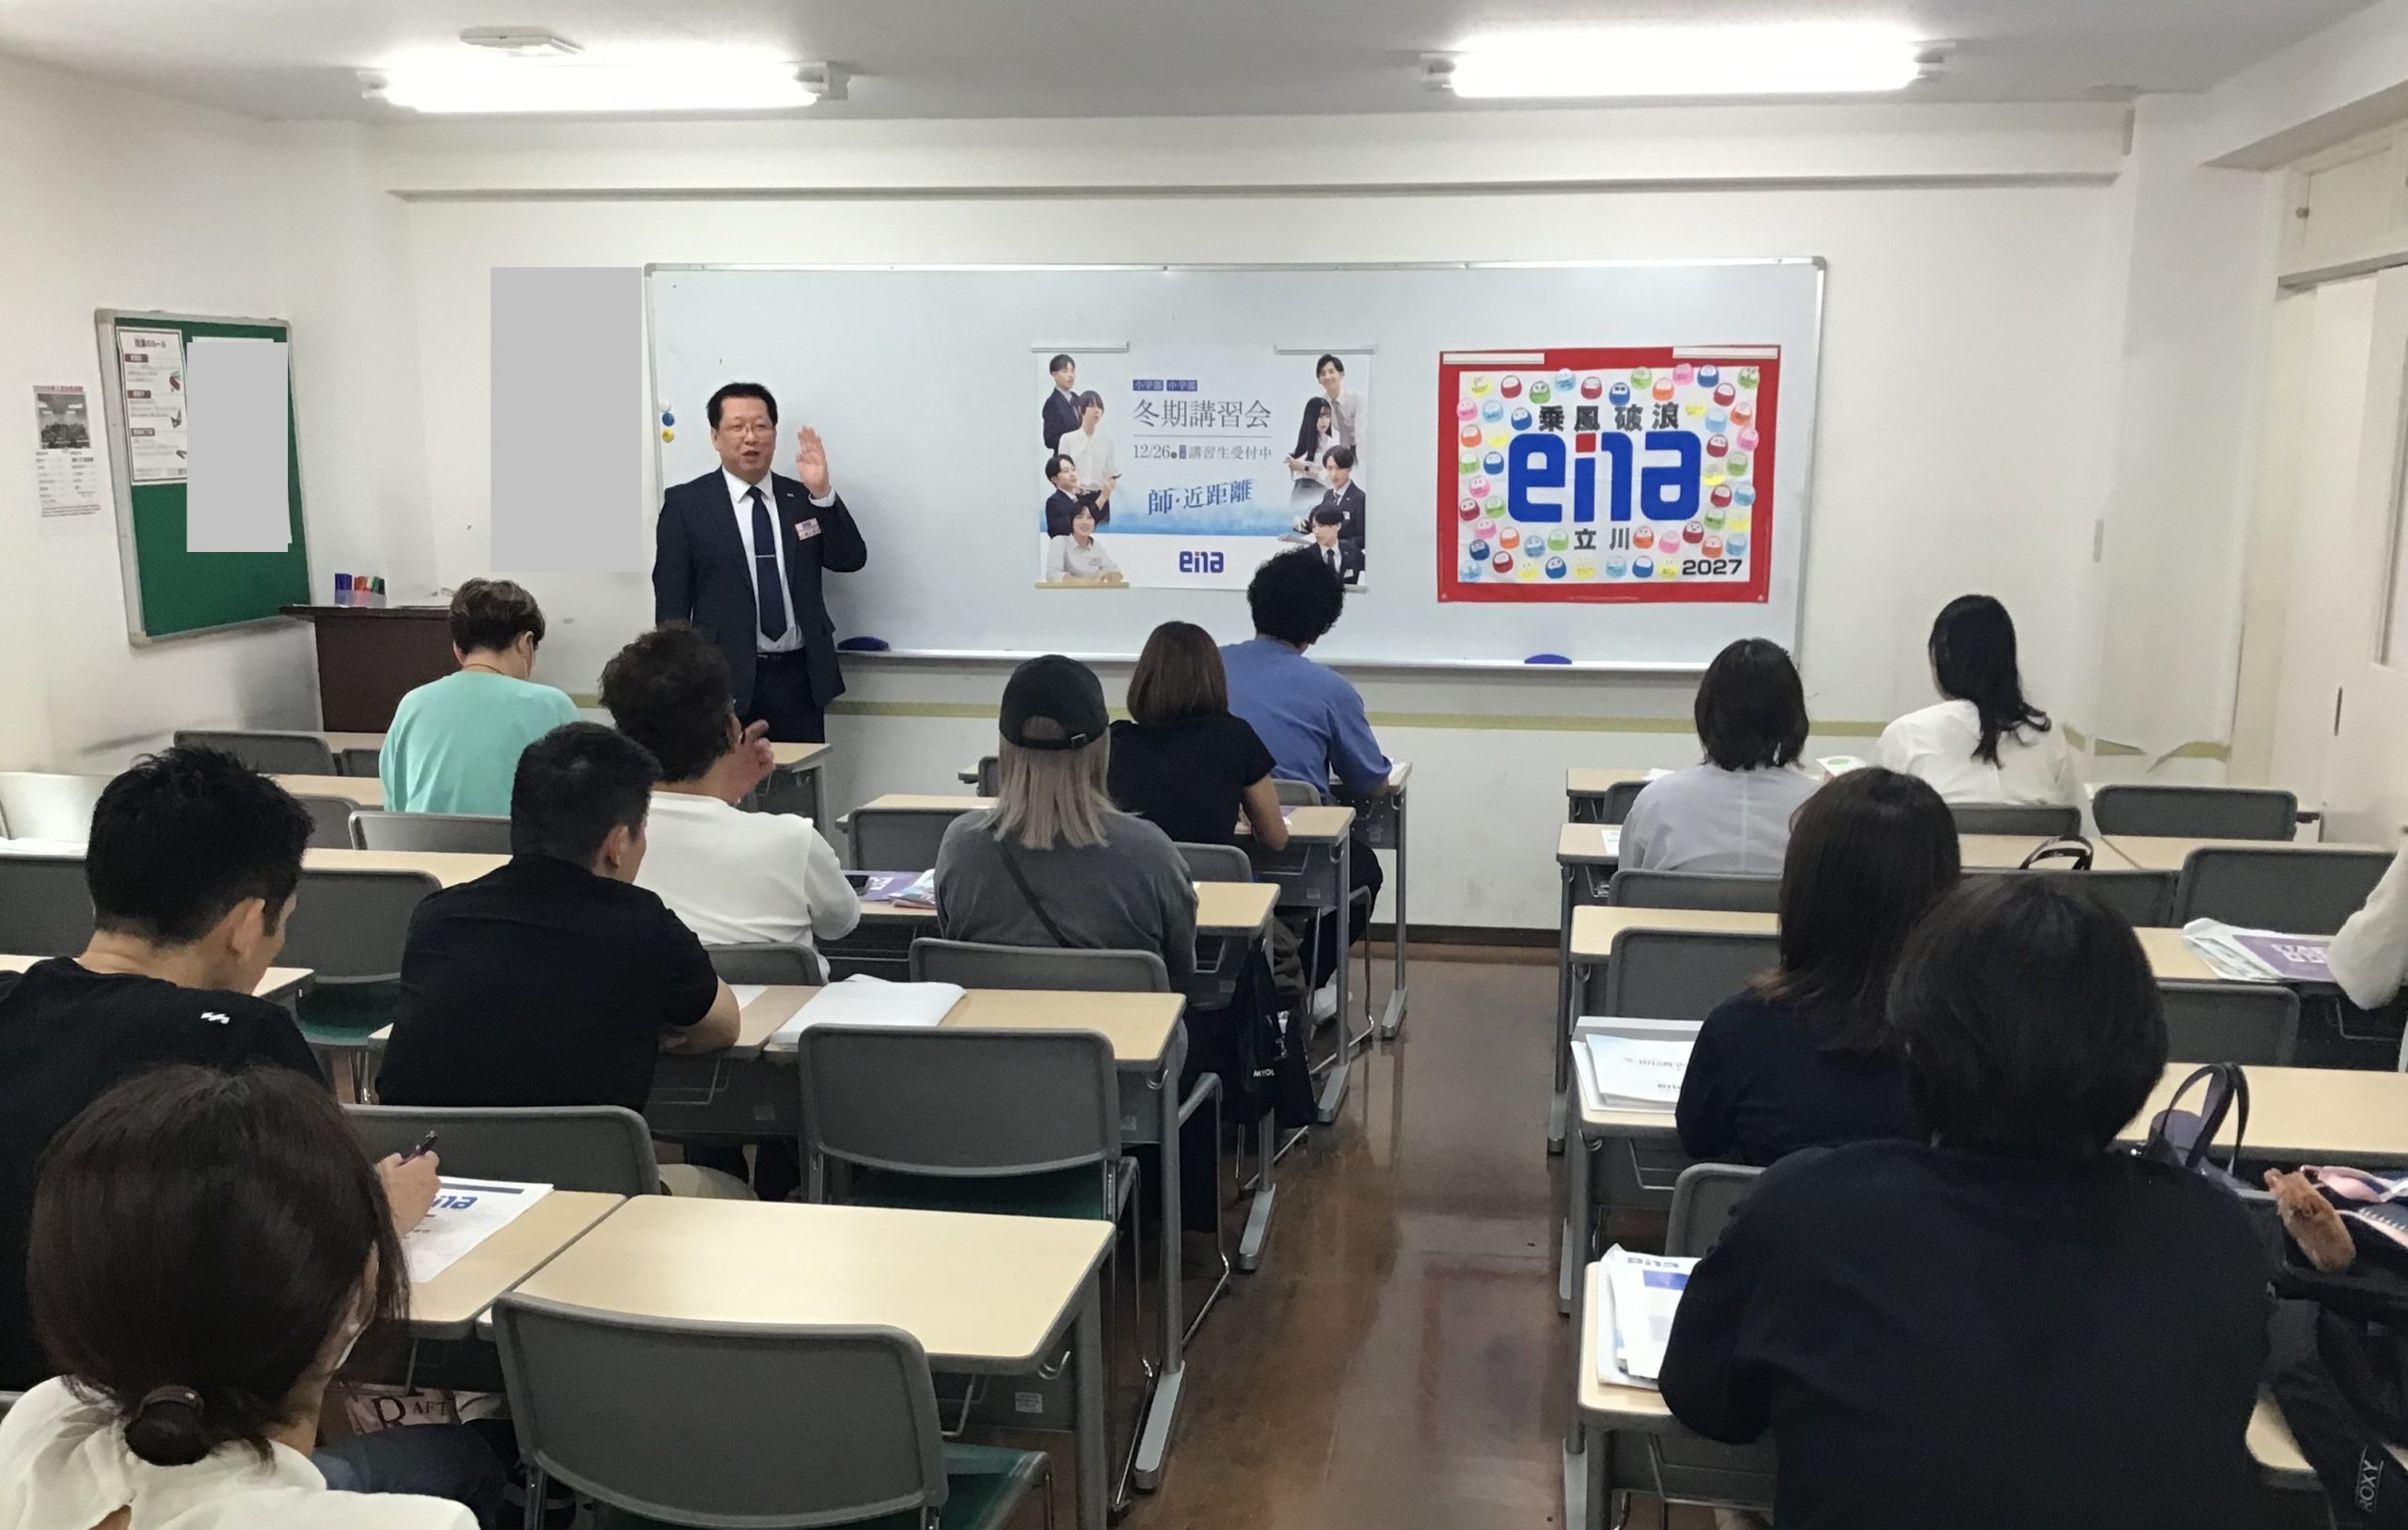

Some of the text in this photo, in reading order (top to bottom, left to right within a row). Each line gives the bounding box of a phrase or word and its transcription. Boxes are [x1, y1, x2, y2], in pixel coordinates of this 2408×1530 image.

[1133, 398, 1272, 429] 冬期講習会
[1574, 528, 1630, 550] 立川
[1682, 559, 1743, 576] 2027
